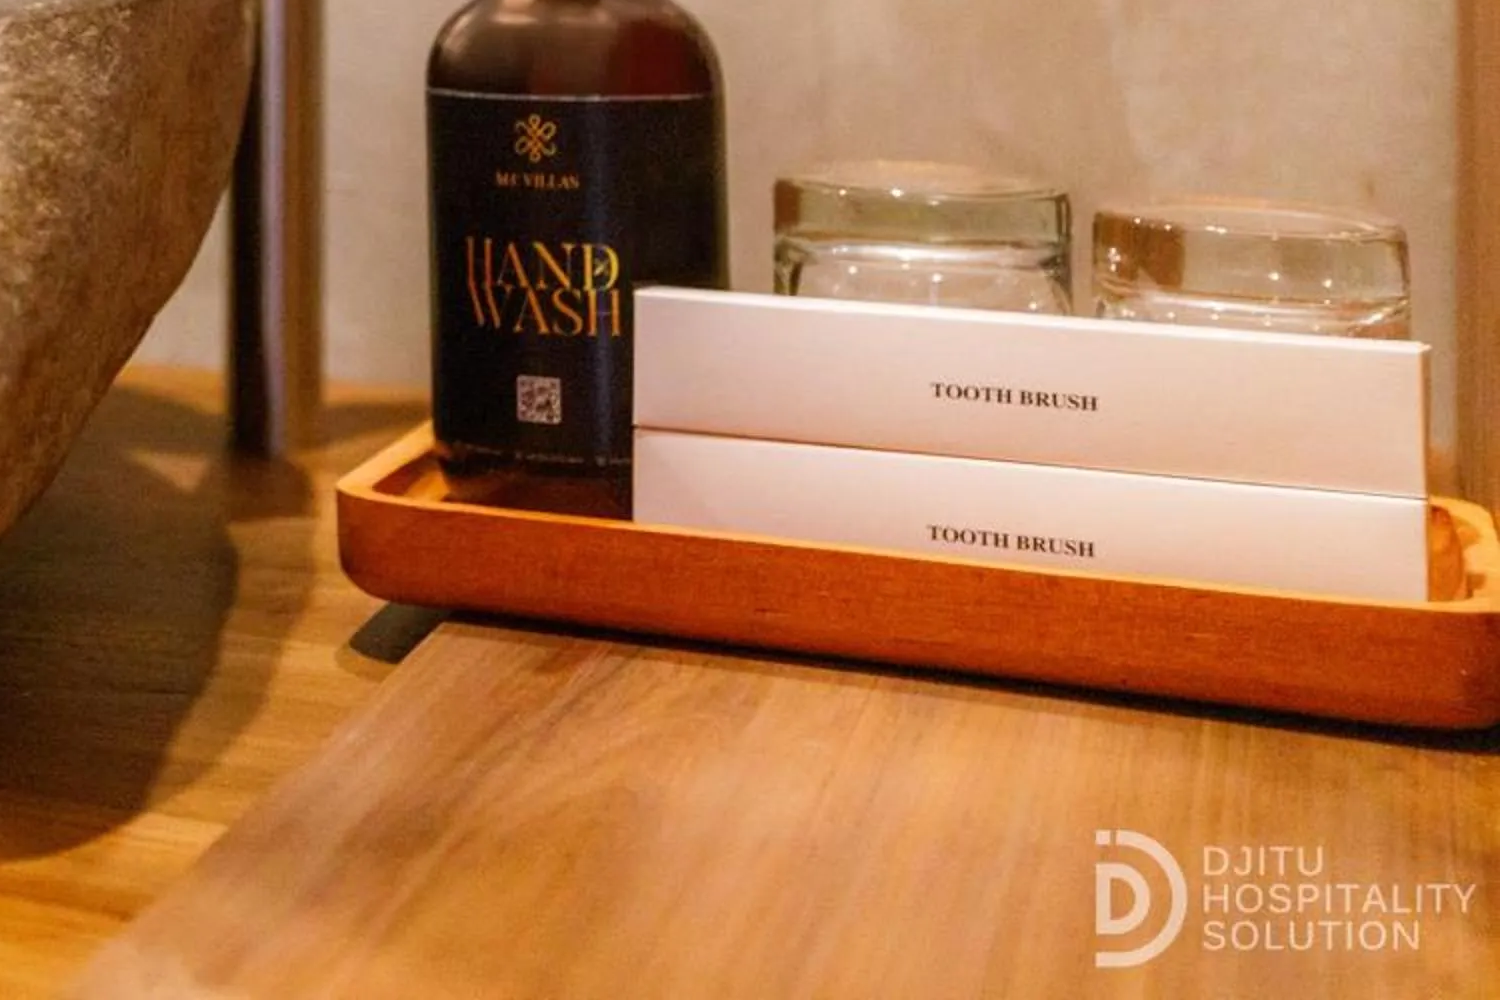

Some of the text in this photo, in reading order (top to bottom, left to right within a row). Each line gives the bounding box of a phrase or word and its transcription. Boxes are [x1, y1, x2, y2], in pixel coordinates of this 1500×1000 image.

[523, 172, 580, 190] VILLAS
[466, 236, 620, 290] HAND
[466, 285, 621, 337] WASH
[931, 382, 1099, 411] TOOTH BRUSH
[927, 525, 1095, 558] TOOTH BRUSH
